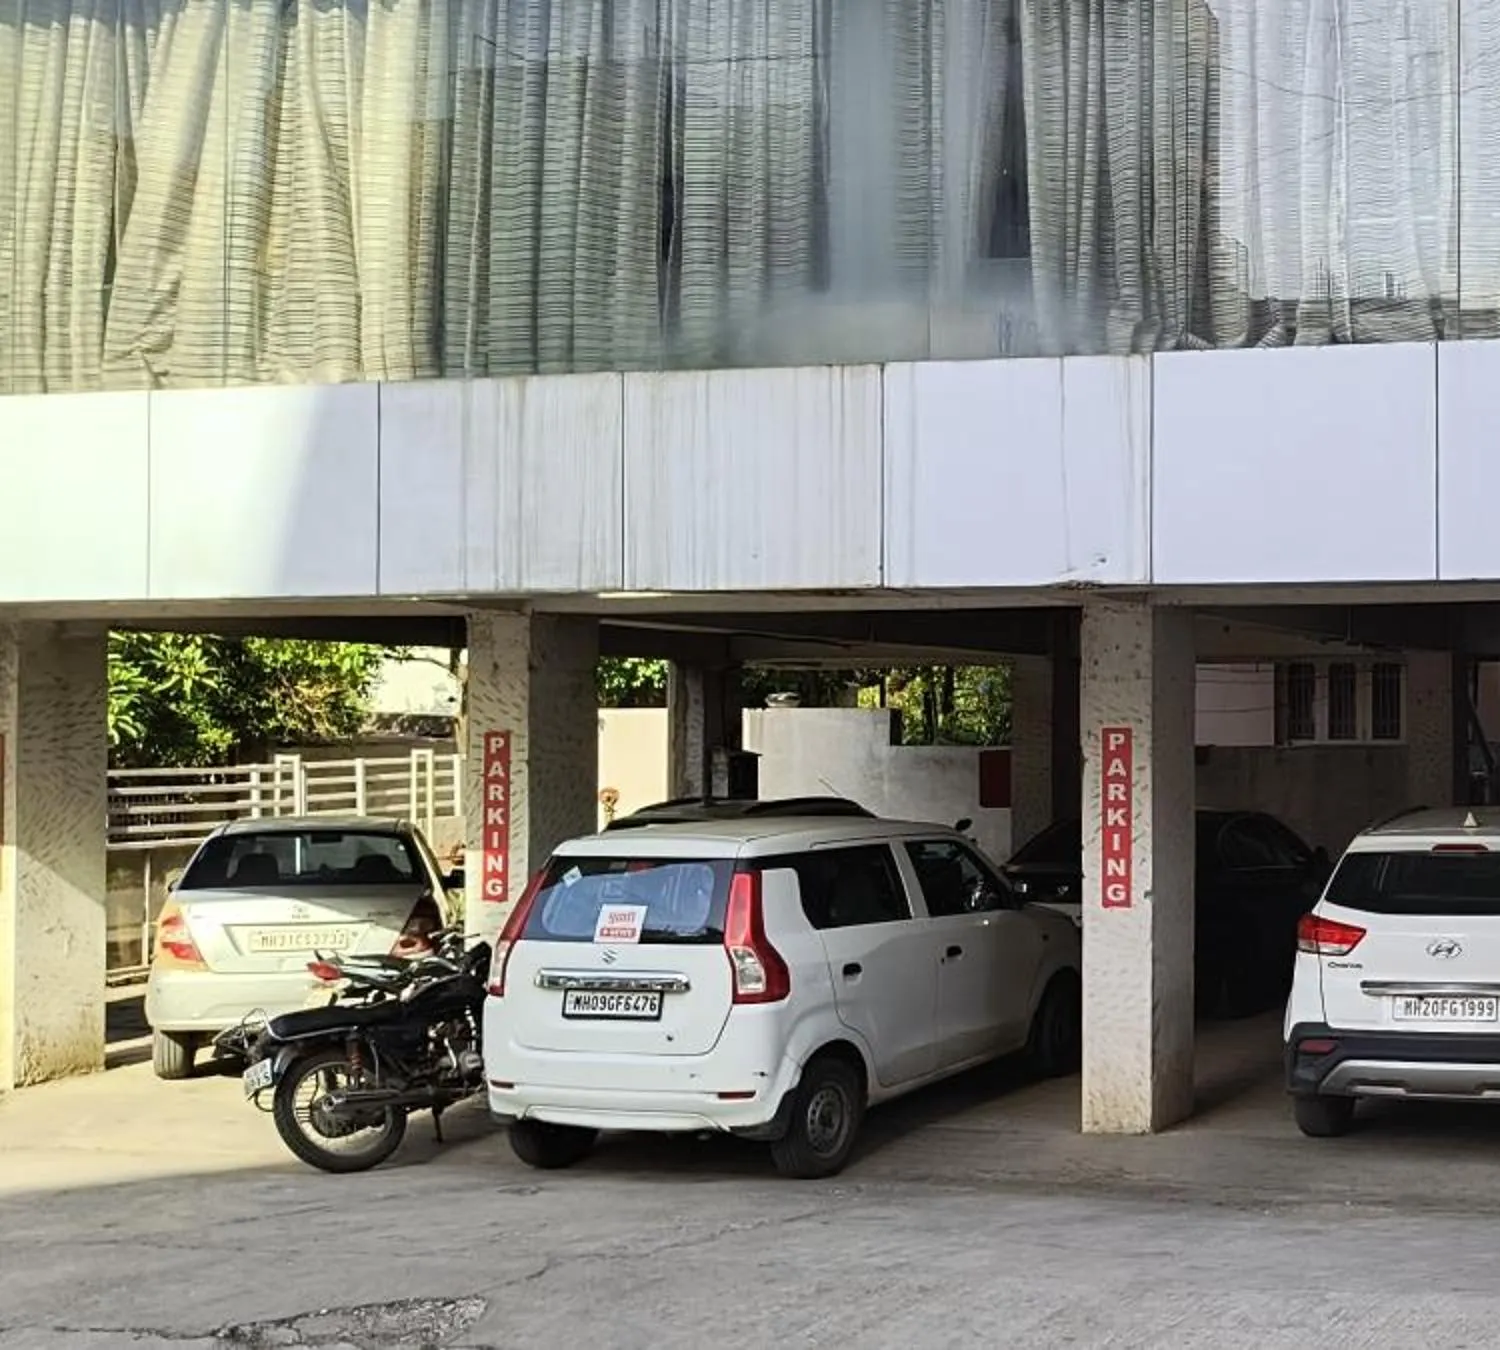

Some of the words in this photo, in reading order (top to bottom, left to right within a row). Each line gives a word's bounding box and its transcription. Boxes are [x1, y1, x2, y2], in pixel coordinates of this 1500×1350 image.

[486, 737, 504, 895] PARKING
[1107, 733, 1127, 900] PARKING
[573, 995, 657, 1012] MH09GF6476
[1403, 1000, 1494, 1017] MH20FG1999
